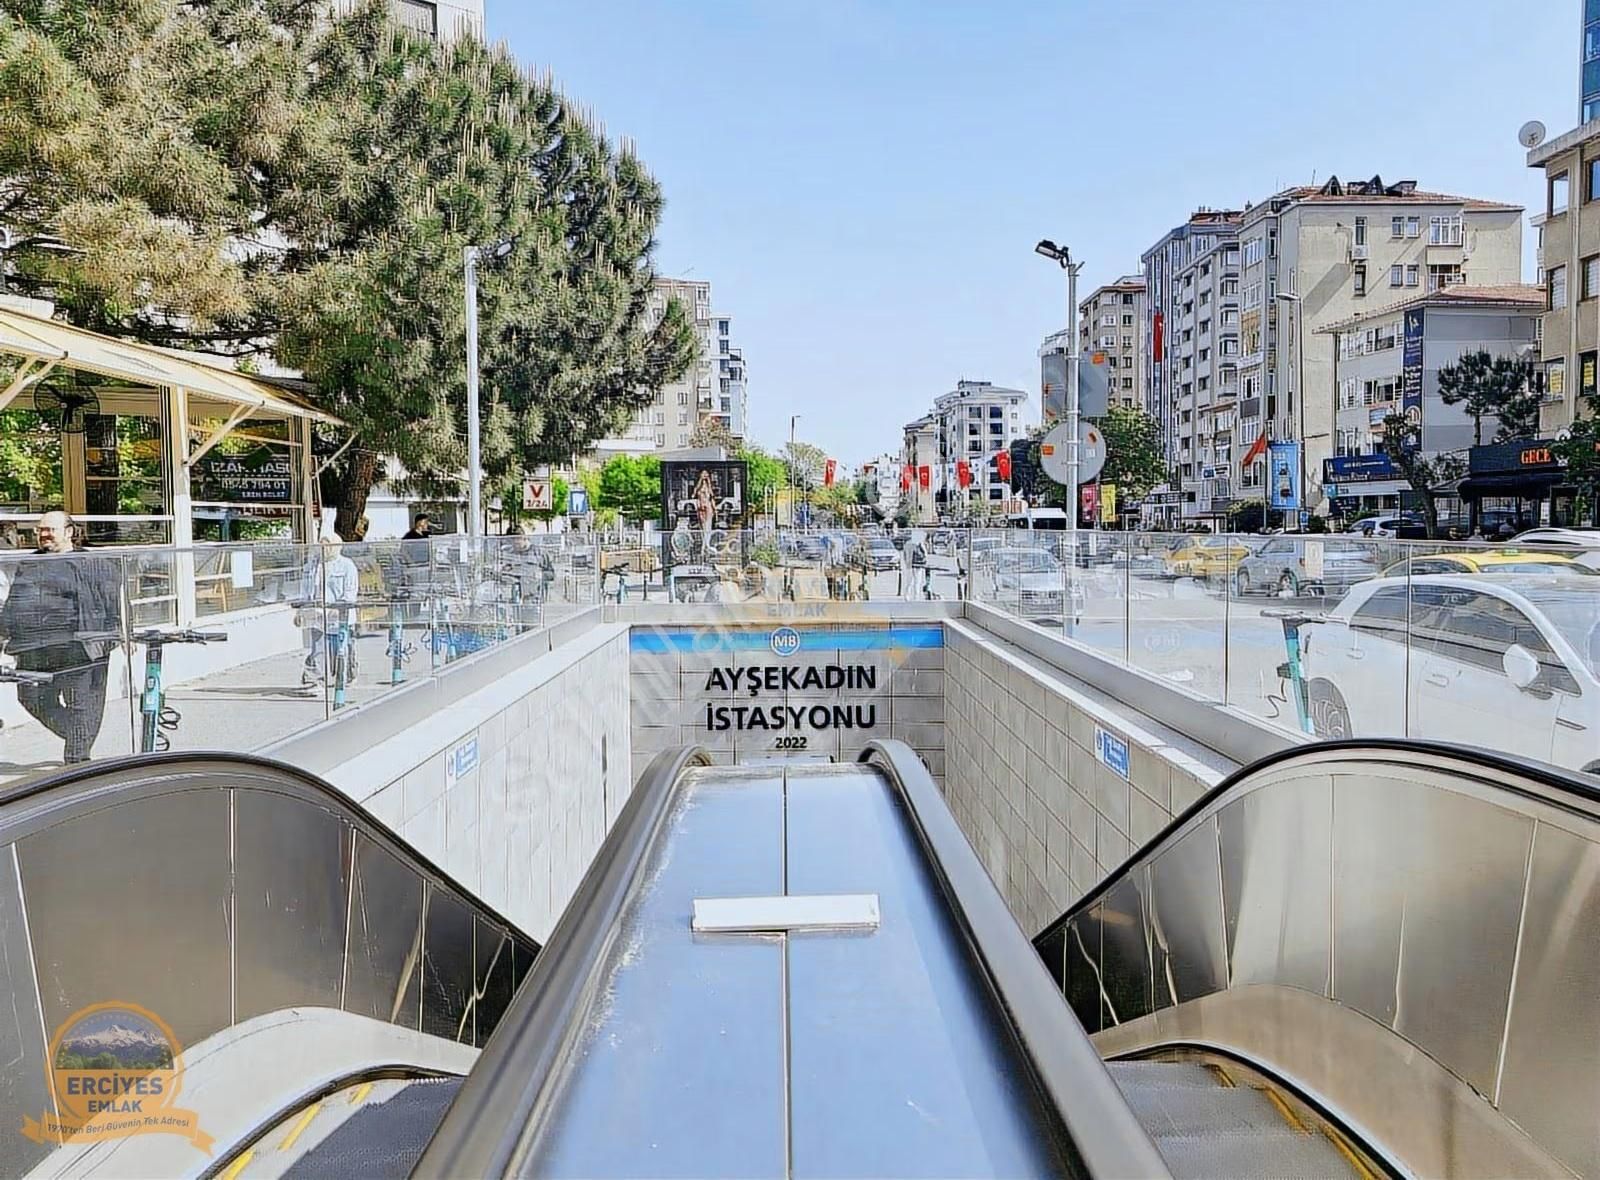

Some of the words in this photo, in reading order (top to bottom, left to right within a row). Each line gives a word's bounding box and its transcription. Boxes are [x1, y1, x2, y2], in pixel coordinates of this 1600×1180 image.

[529, 484, 544, 498] V
[704, 665, 877, 697] AYŞEKADIN
[706, 703, 876, 731] İSTASYONU
[775, 736, 808, 749] 2022
